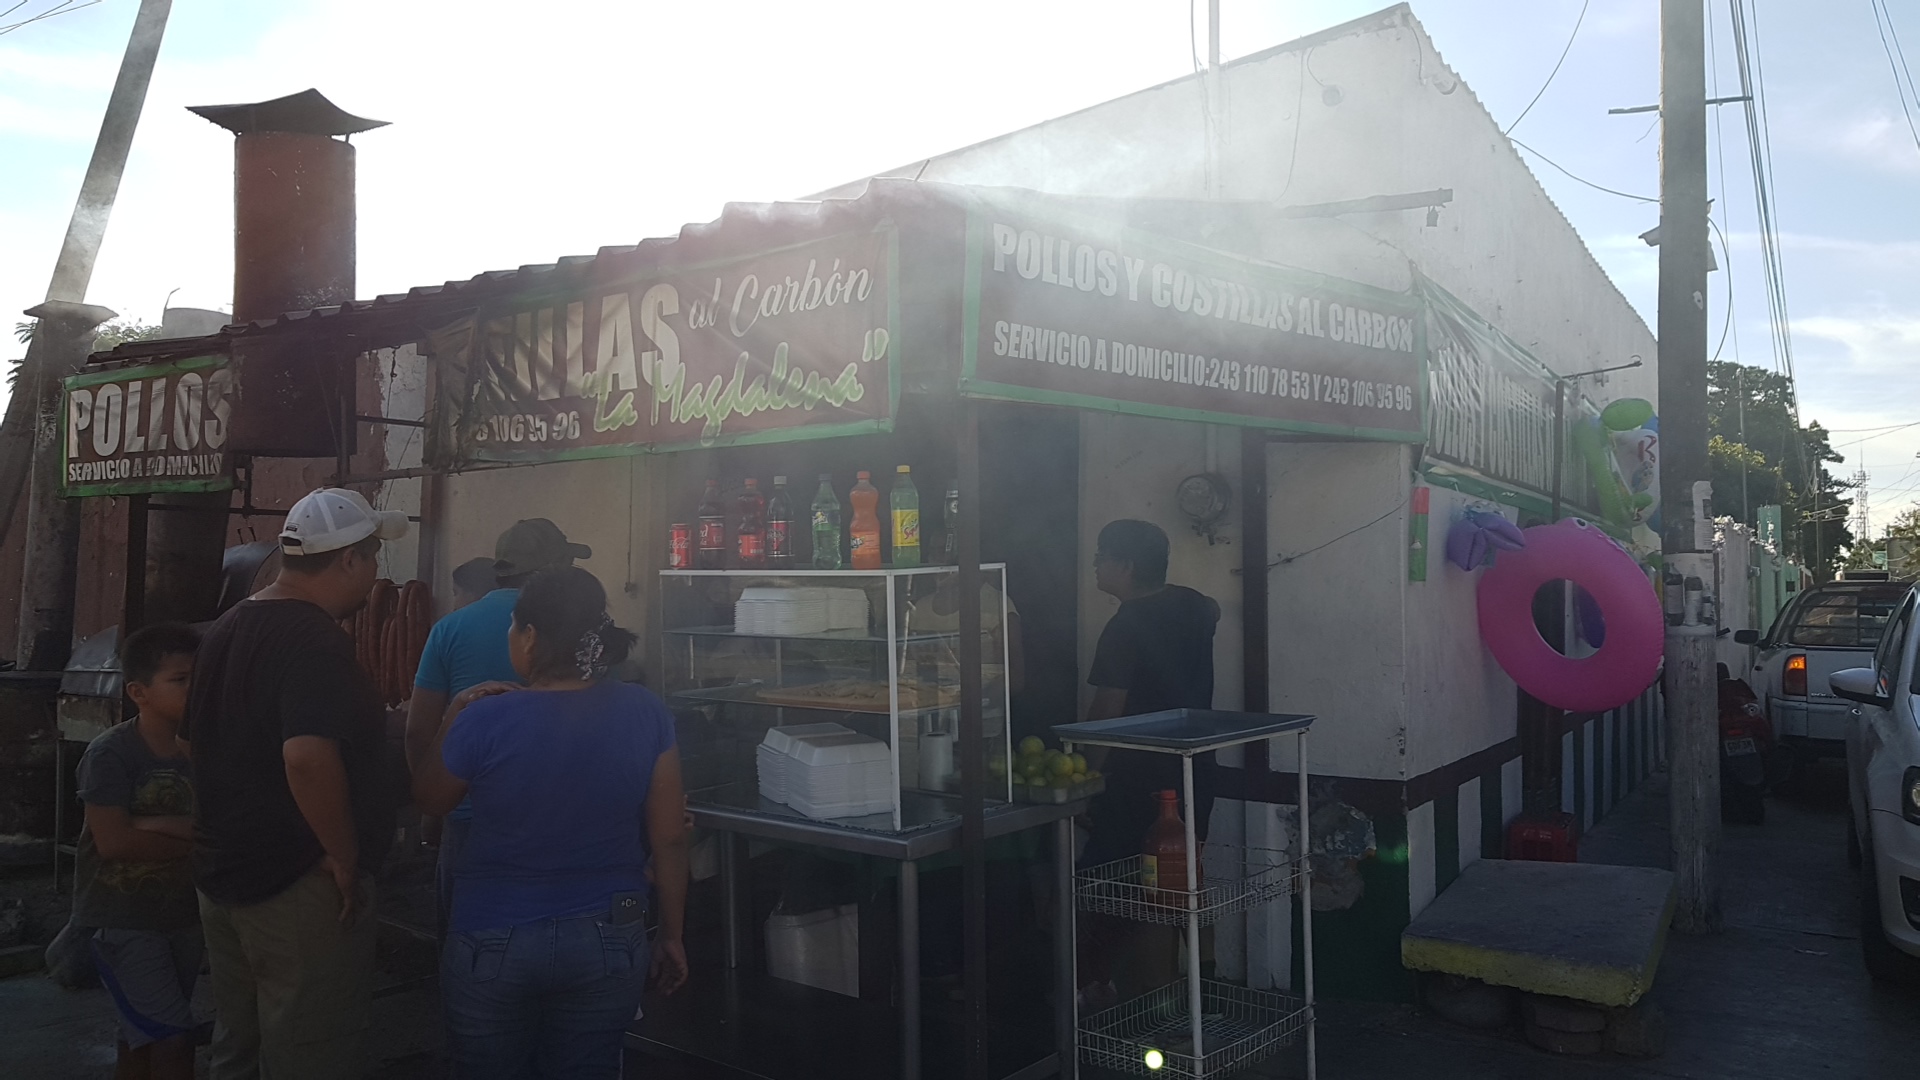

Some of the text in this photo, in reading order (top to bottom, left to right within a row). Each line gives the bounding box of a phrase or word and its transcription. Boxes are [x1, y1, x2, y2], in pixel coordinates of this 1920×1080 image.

[688, 277, 722, 331] al
[729, 258, 875, 338] Carbón
[992, 223, 1118, 297] POLLOS
[1123, 255, 1145, 302] Y
[1151, 262, 1295, 332] COSTILLAS
[1296, 297, 1326, 338] AL
[993, 320, 1091, 370] SERVICIO
[1094, 338, 1108, 371] A
[1244, 363, 1268, 396] 110
[1271, 367, 1289, 399] 78
[1291, 371, 1310, 401] 53
[1313, 374, 1322, 402] Y
[1323, 375, 1350, 406] 243
[1352, 380, 1374, 408] 106
[1395, 384, 1413, 412] 96
[69, 369, 232, 458] POLLOS
[551, 410, 581, 441] 96
[68, 458, 130, 483] SERVICIO
[132, 457, 144, 477] A
